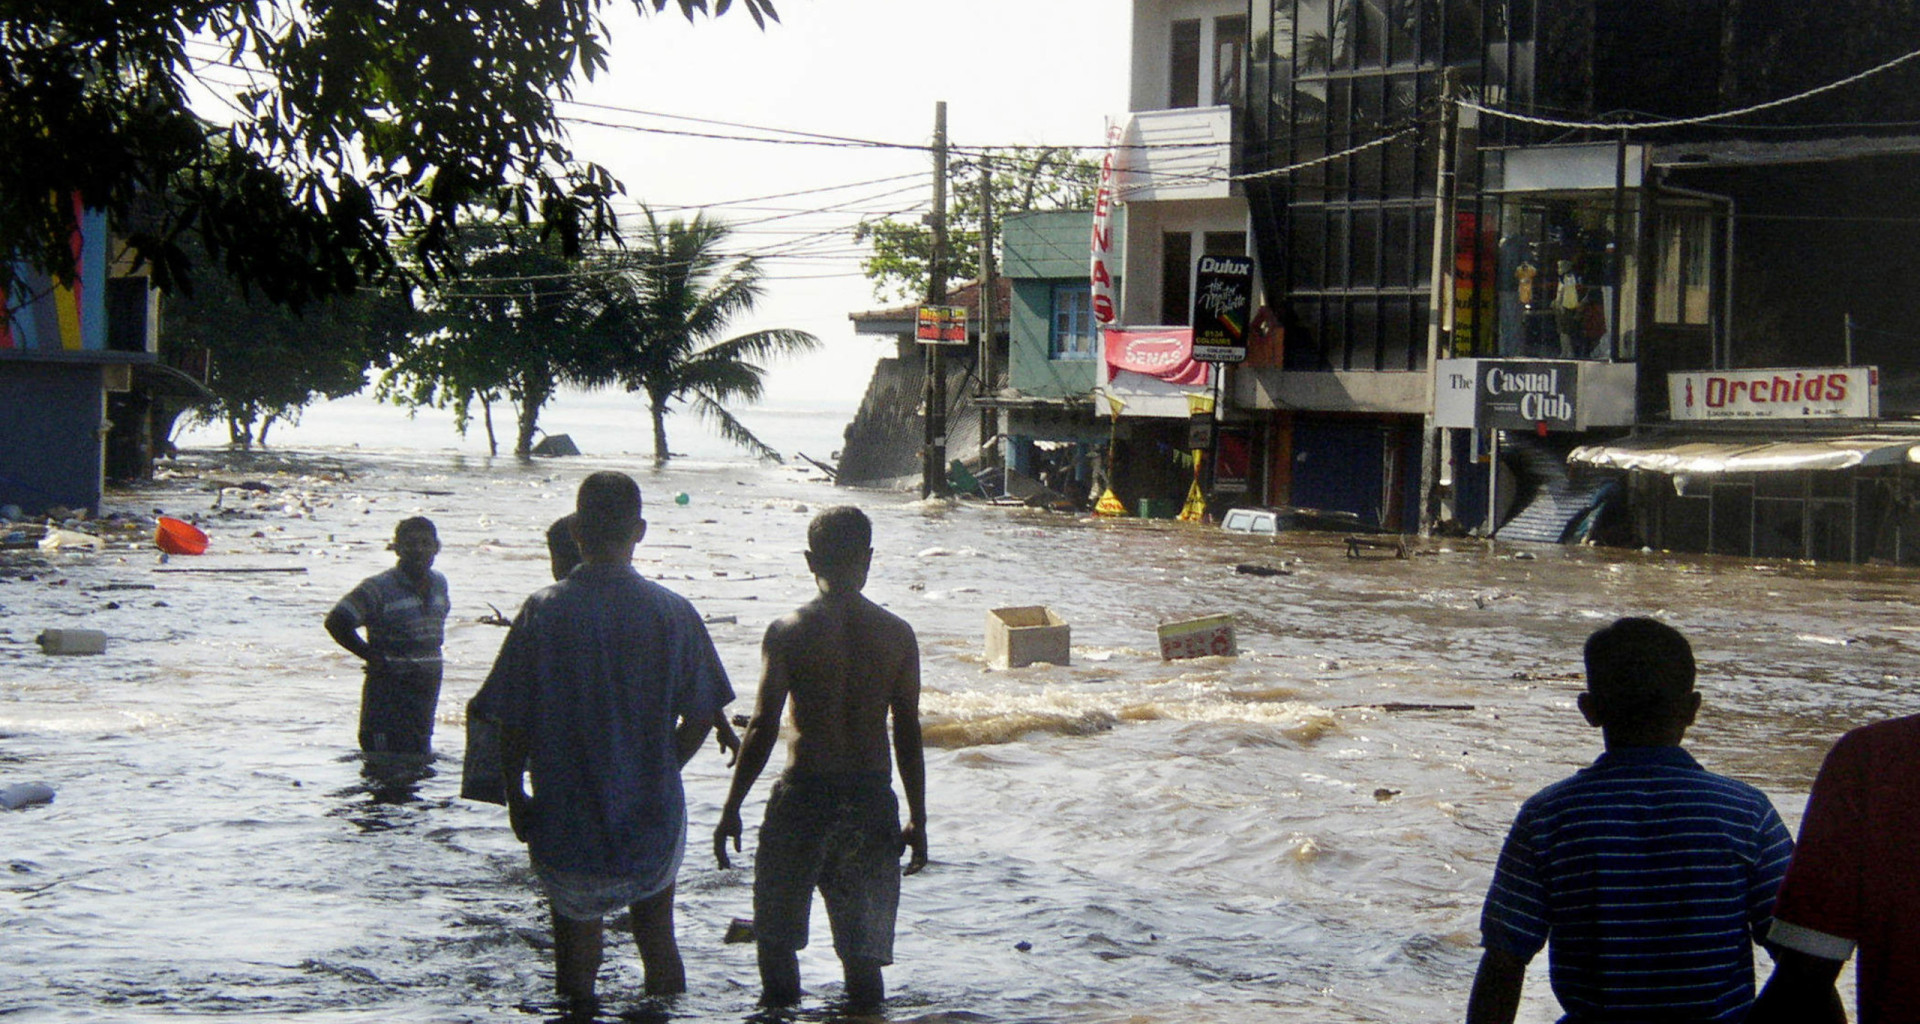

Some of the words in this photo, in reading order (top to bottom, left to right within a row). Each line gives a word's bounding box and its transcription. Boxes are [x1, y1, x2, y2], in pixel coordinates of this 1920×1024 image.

[1200, 257, 1250, 275] Dulux
[1449, 373, 1473, 390] The
[1486, 367, 1557, 396] Casual
[1521, 392, 1572, 421] Club
